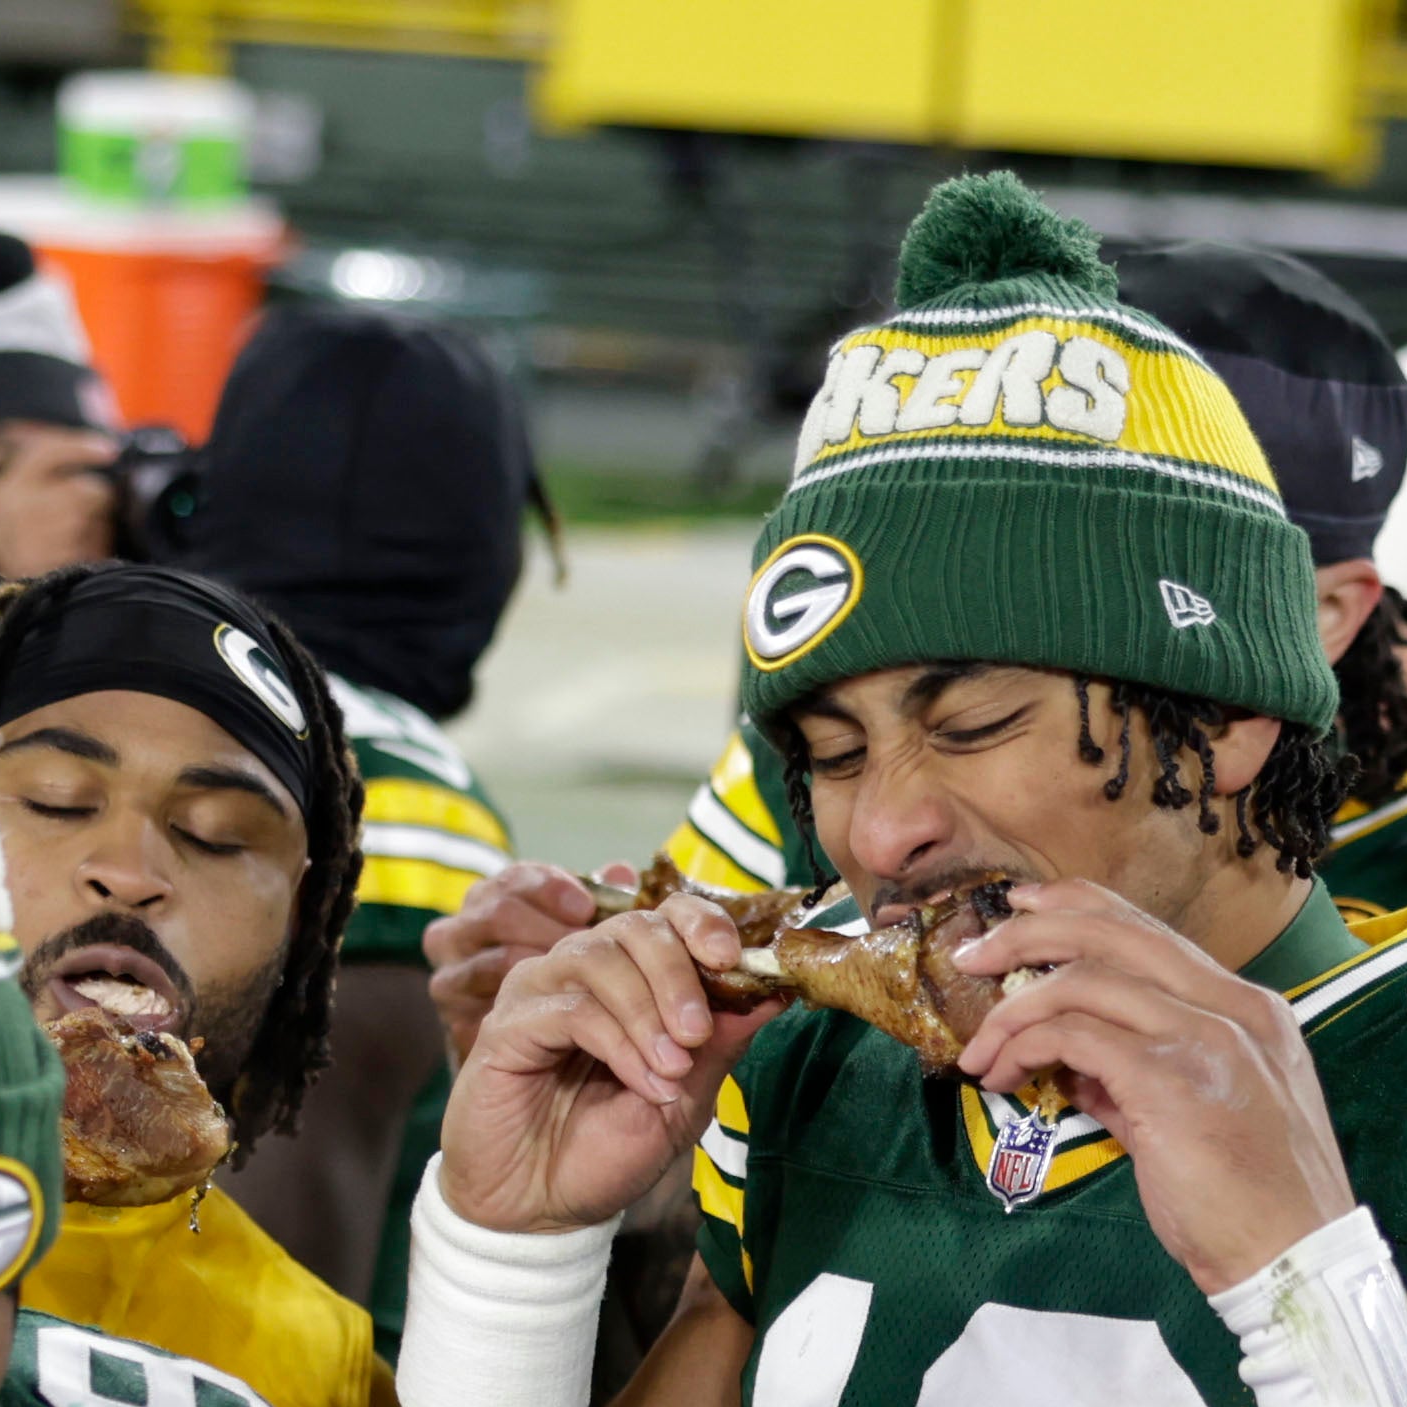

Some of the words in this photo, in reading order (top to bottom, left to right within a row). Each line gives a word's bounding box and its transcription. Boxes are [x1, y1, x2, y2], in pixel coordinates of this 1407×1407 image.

[795, 331, 1130, 476] KERS
[747, 548, 848, 659] G
[994, 1151, 1032, 1193] NFL
